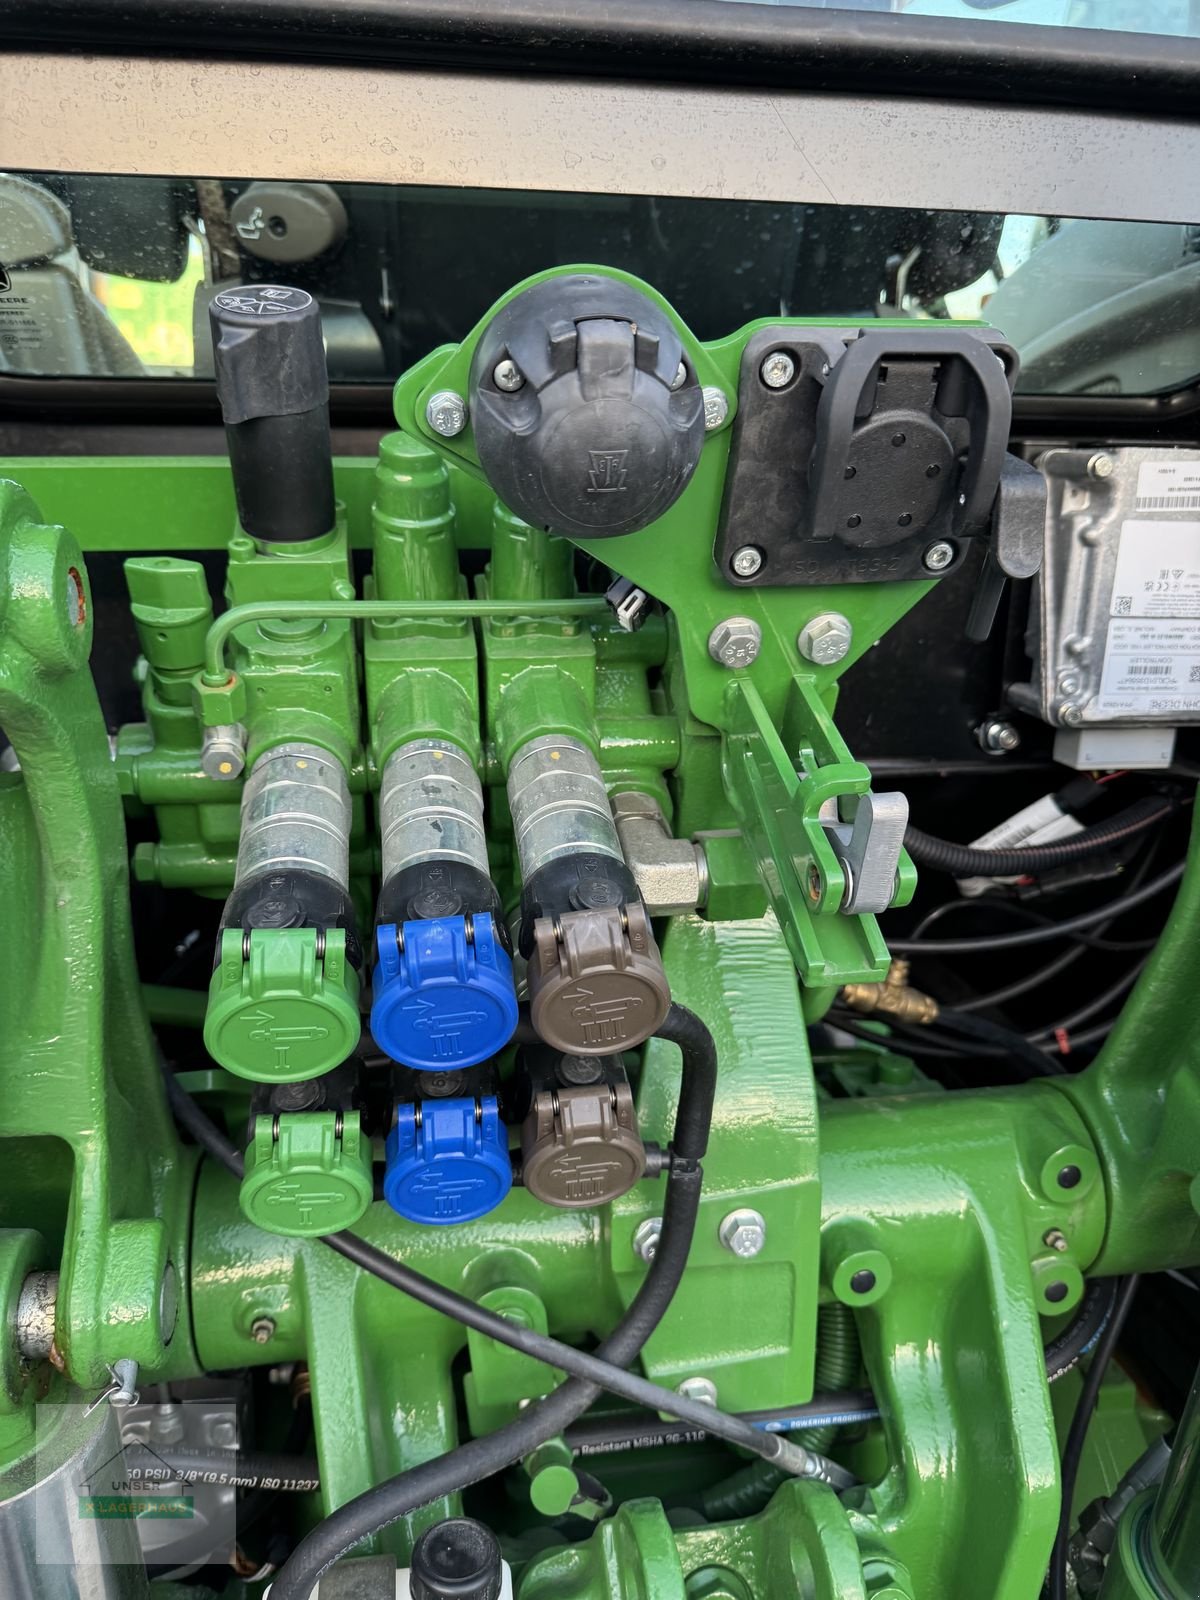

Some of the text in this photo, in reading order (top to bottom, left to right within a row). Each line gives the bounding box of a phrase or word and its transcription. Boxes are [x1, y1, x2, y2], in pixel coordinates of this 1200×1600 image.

[581, 1440, 630, 1455] Resistant
[126, 1468, 141, 1481] 50
[259, 1477, 280, 1489] ISO
[282, 1479, 319, 1491] 11237
